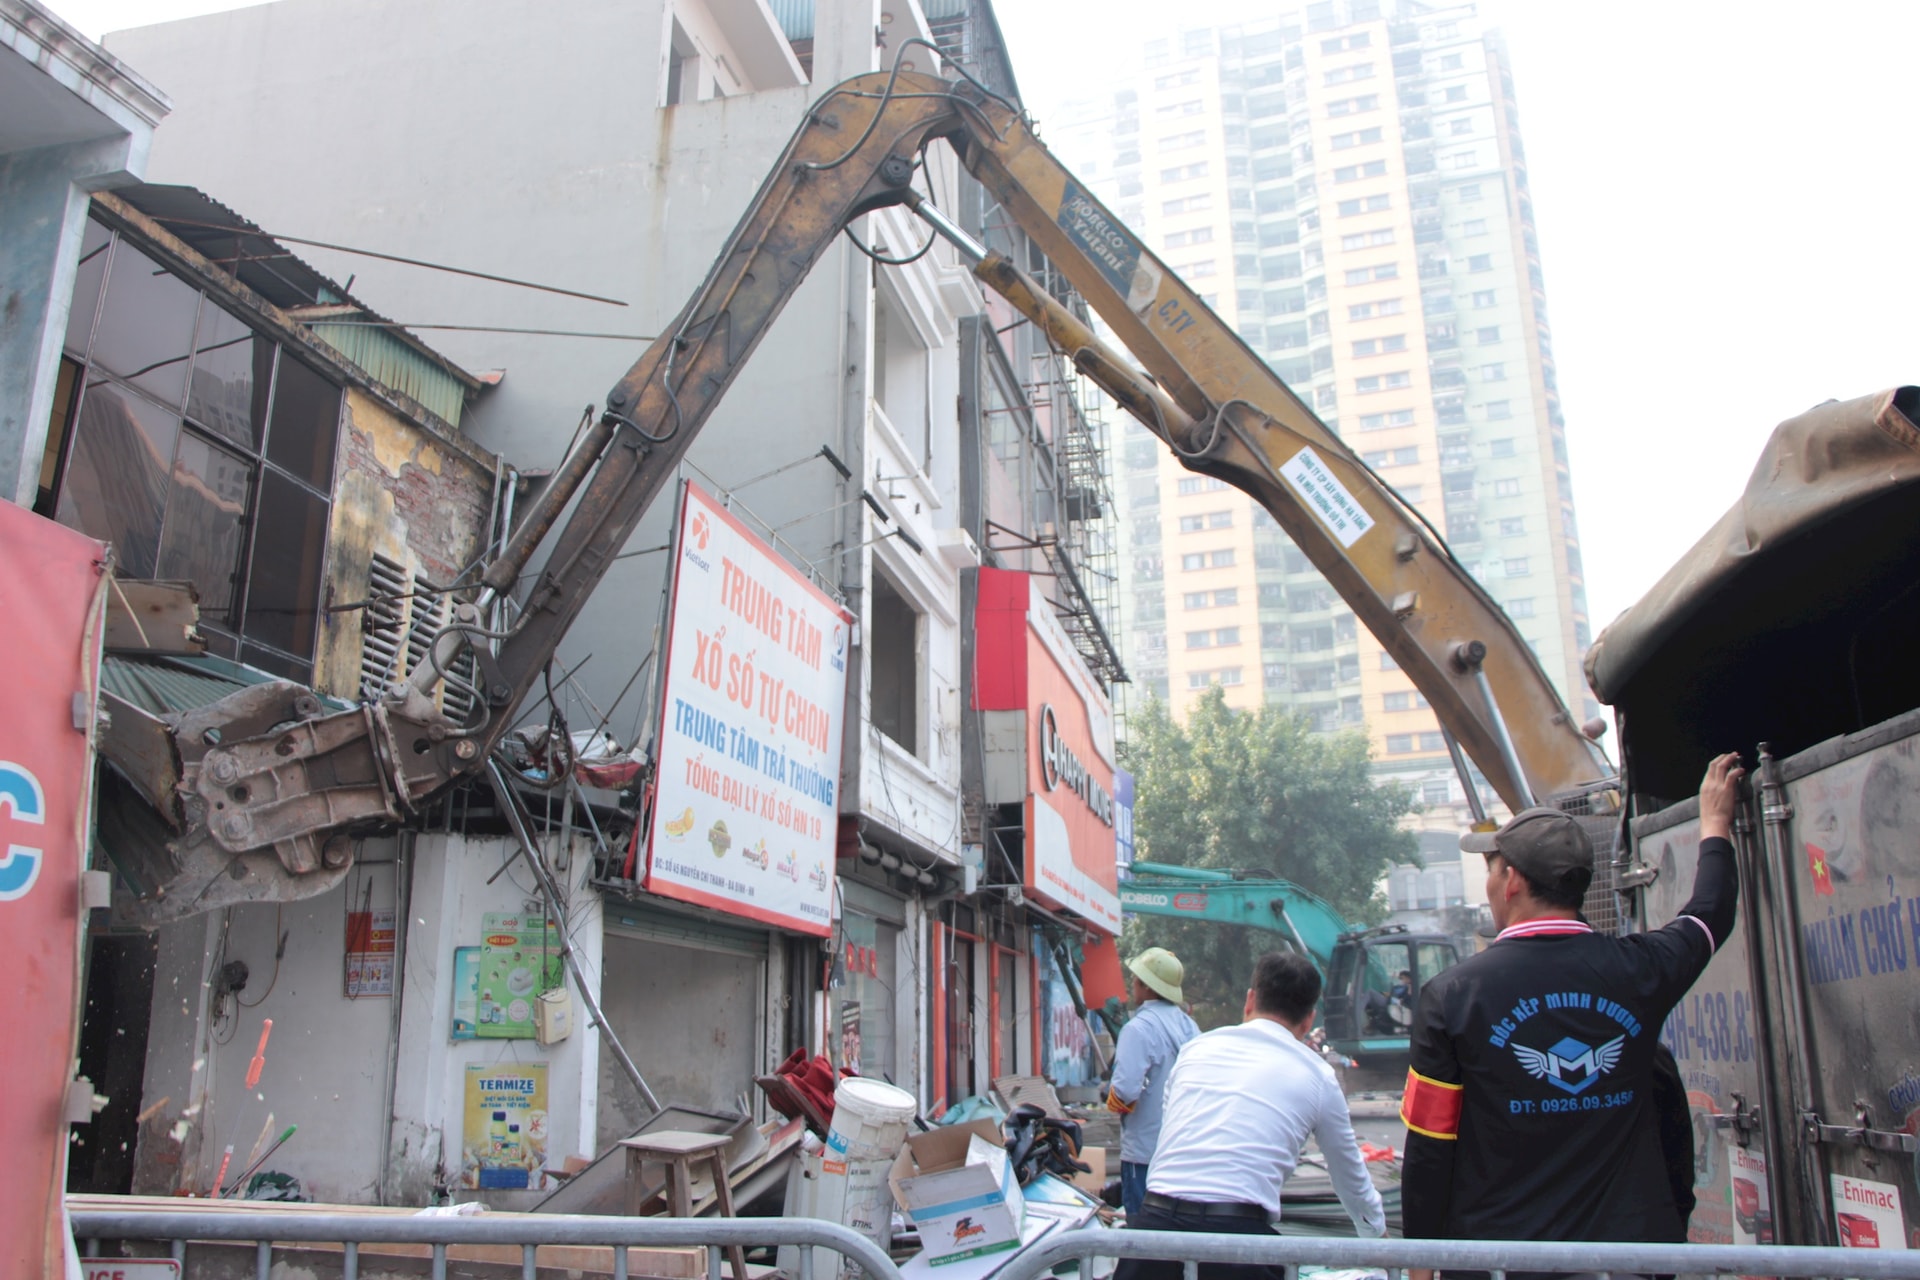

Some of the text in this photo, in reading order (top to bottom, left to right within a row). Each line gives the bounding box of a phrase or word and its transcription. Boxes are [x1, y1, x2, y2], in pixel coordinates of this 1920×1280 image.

[1072, 198, 1123, 248] KOBELCO
[1073, 220, 1124, 270] Yutani
[685, 546, 710, 573] Vietlott
[721, 556, 822, 672] TRUNG TÂM
[692, 626, 830, 756] XỔ SỐ TỰ CHỌN
[675, 698, 833, 807] TRUNG TÂM TRẢ THƯỞNG
[686, 753, 719, 797] TỔNG
[722, 775, 743, 811] ĐẠI
[761, 788, 777, 822] XỔ
[778, 798, 792, 828] SỐ
[793, 808, 808, 836] HN
[810, 817, 822, 841] 19
[1121, 892, 1168, 906] KOBELCO
[1803, 905, 1861, 985] NHÂN
[1860, 874, 1907, 976] CHỞ
[1489, 992, 1642, 1048] BỐC XẾP MINH VƯƠNG
[479, 1080, 534, 1090] TERMIZE
[1509, 1100, 1536, 1114] ĐT:
[1843, 1180, 1894, 1209] Enimac
